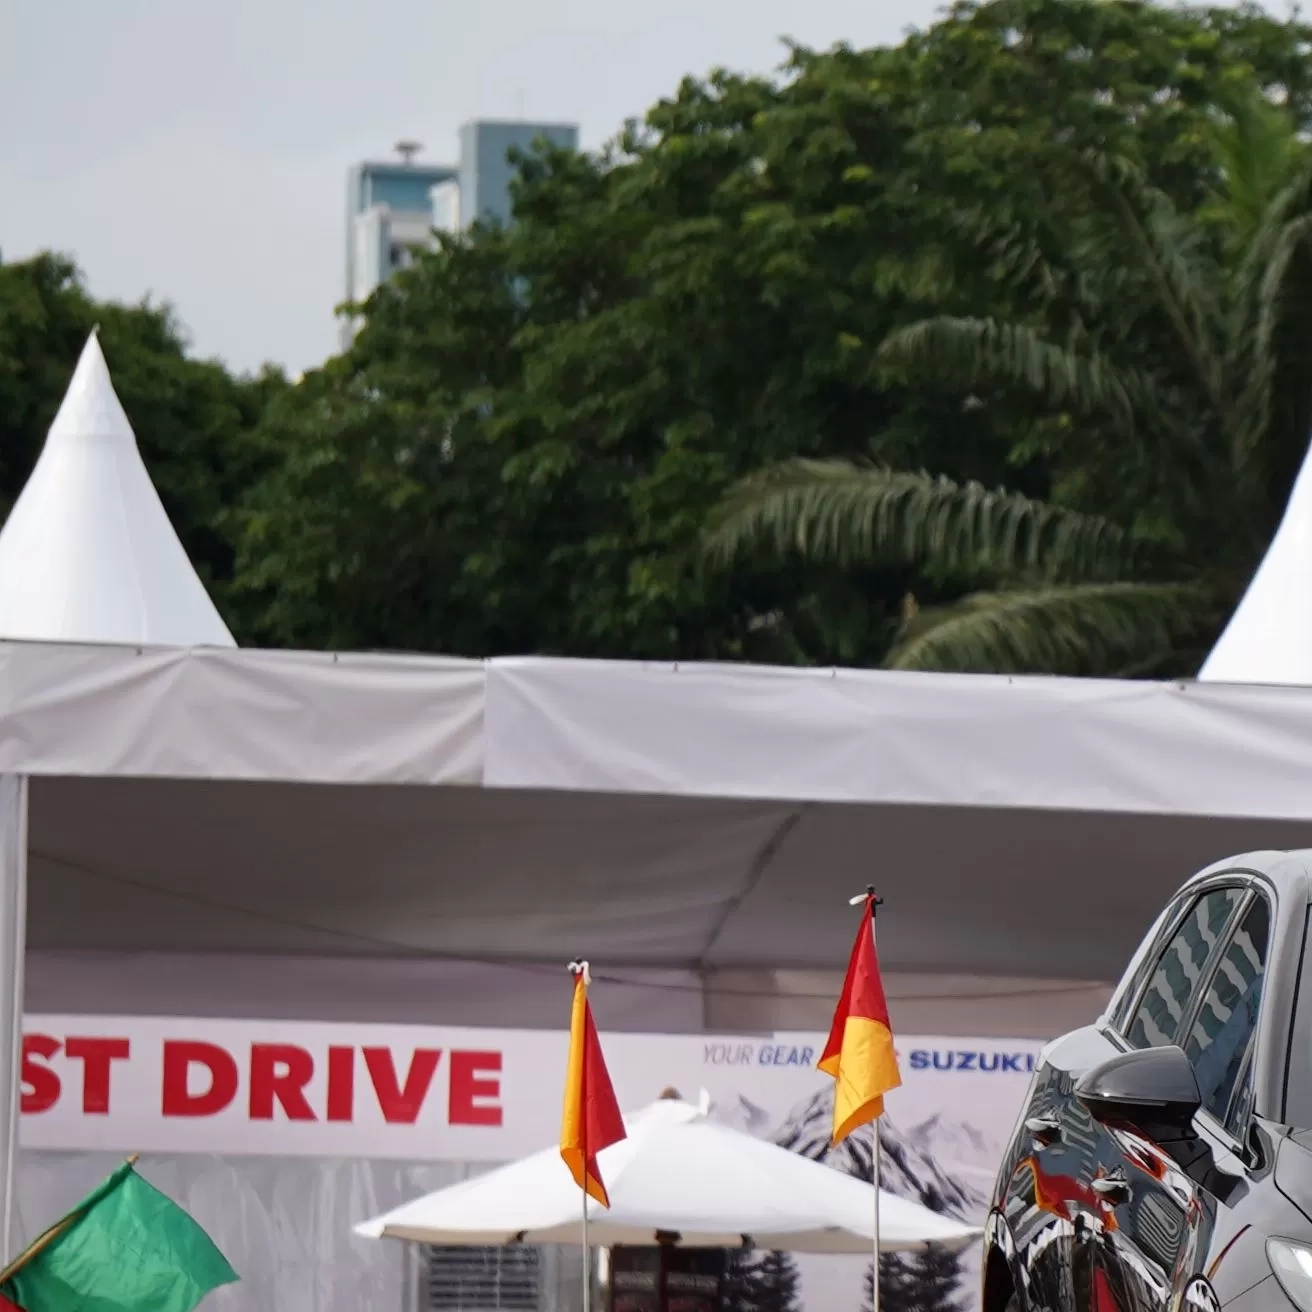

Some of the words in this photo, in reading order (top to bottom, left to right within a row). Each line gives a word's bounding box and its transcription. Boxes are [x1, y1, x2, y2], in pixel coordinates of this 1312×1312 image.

[704, 1044, 753, 1066] YOUR
[759, 1045, 814, 1067] GEAR
[910, 1051, 1035, 1073] SUZUKI
[162, 1039, 503, 1127] DRIVE
